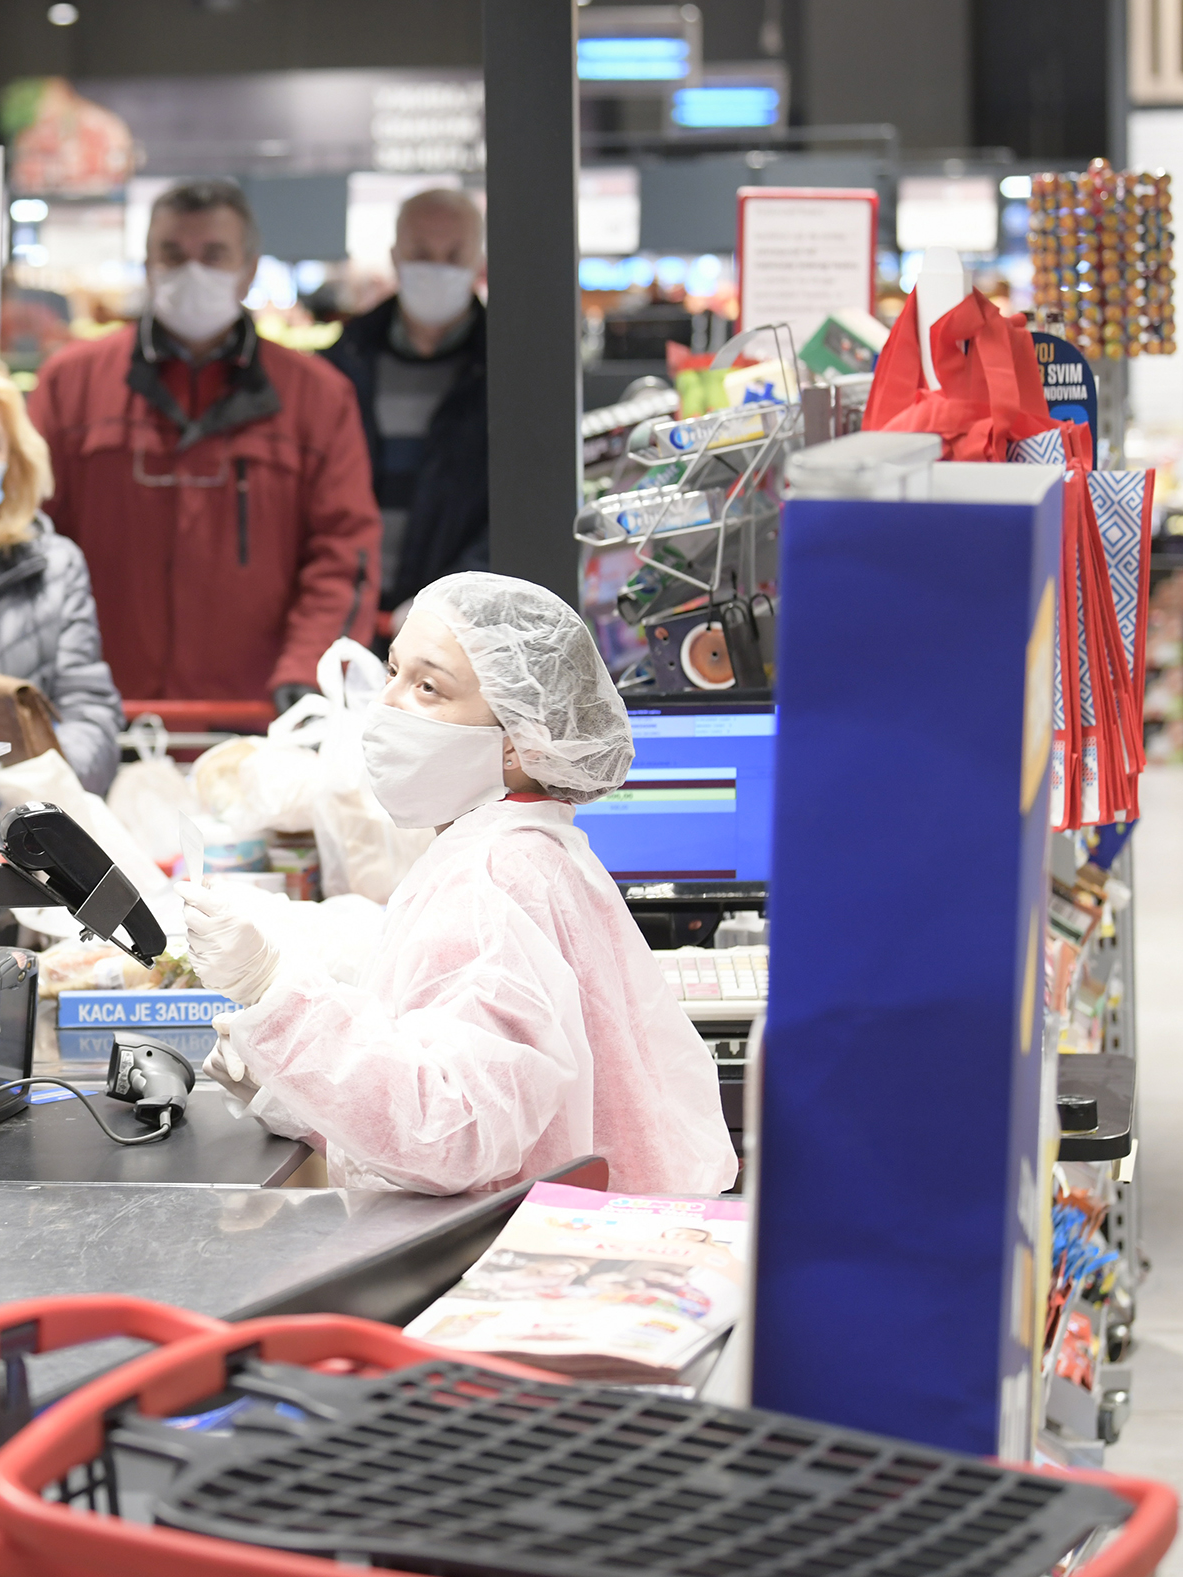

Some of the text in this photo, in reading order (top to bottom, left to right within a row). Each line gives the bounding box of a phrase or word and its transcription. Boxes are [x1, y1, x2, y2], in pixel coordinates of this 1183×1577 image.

[1047, 363, 1083, 384] SVIM
[78, 1003, 126, 1022] КАСА
[129, 1003, 152, 1022] ЈЕ
